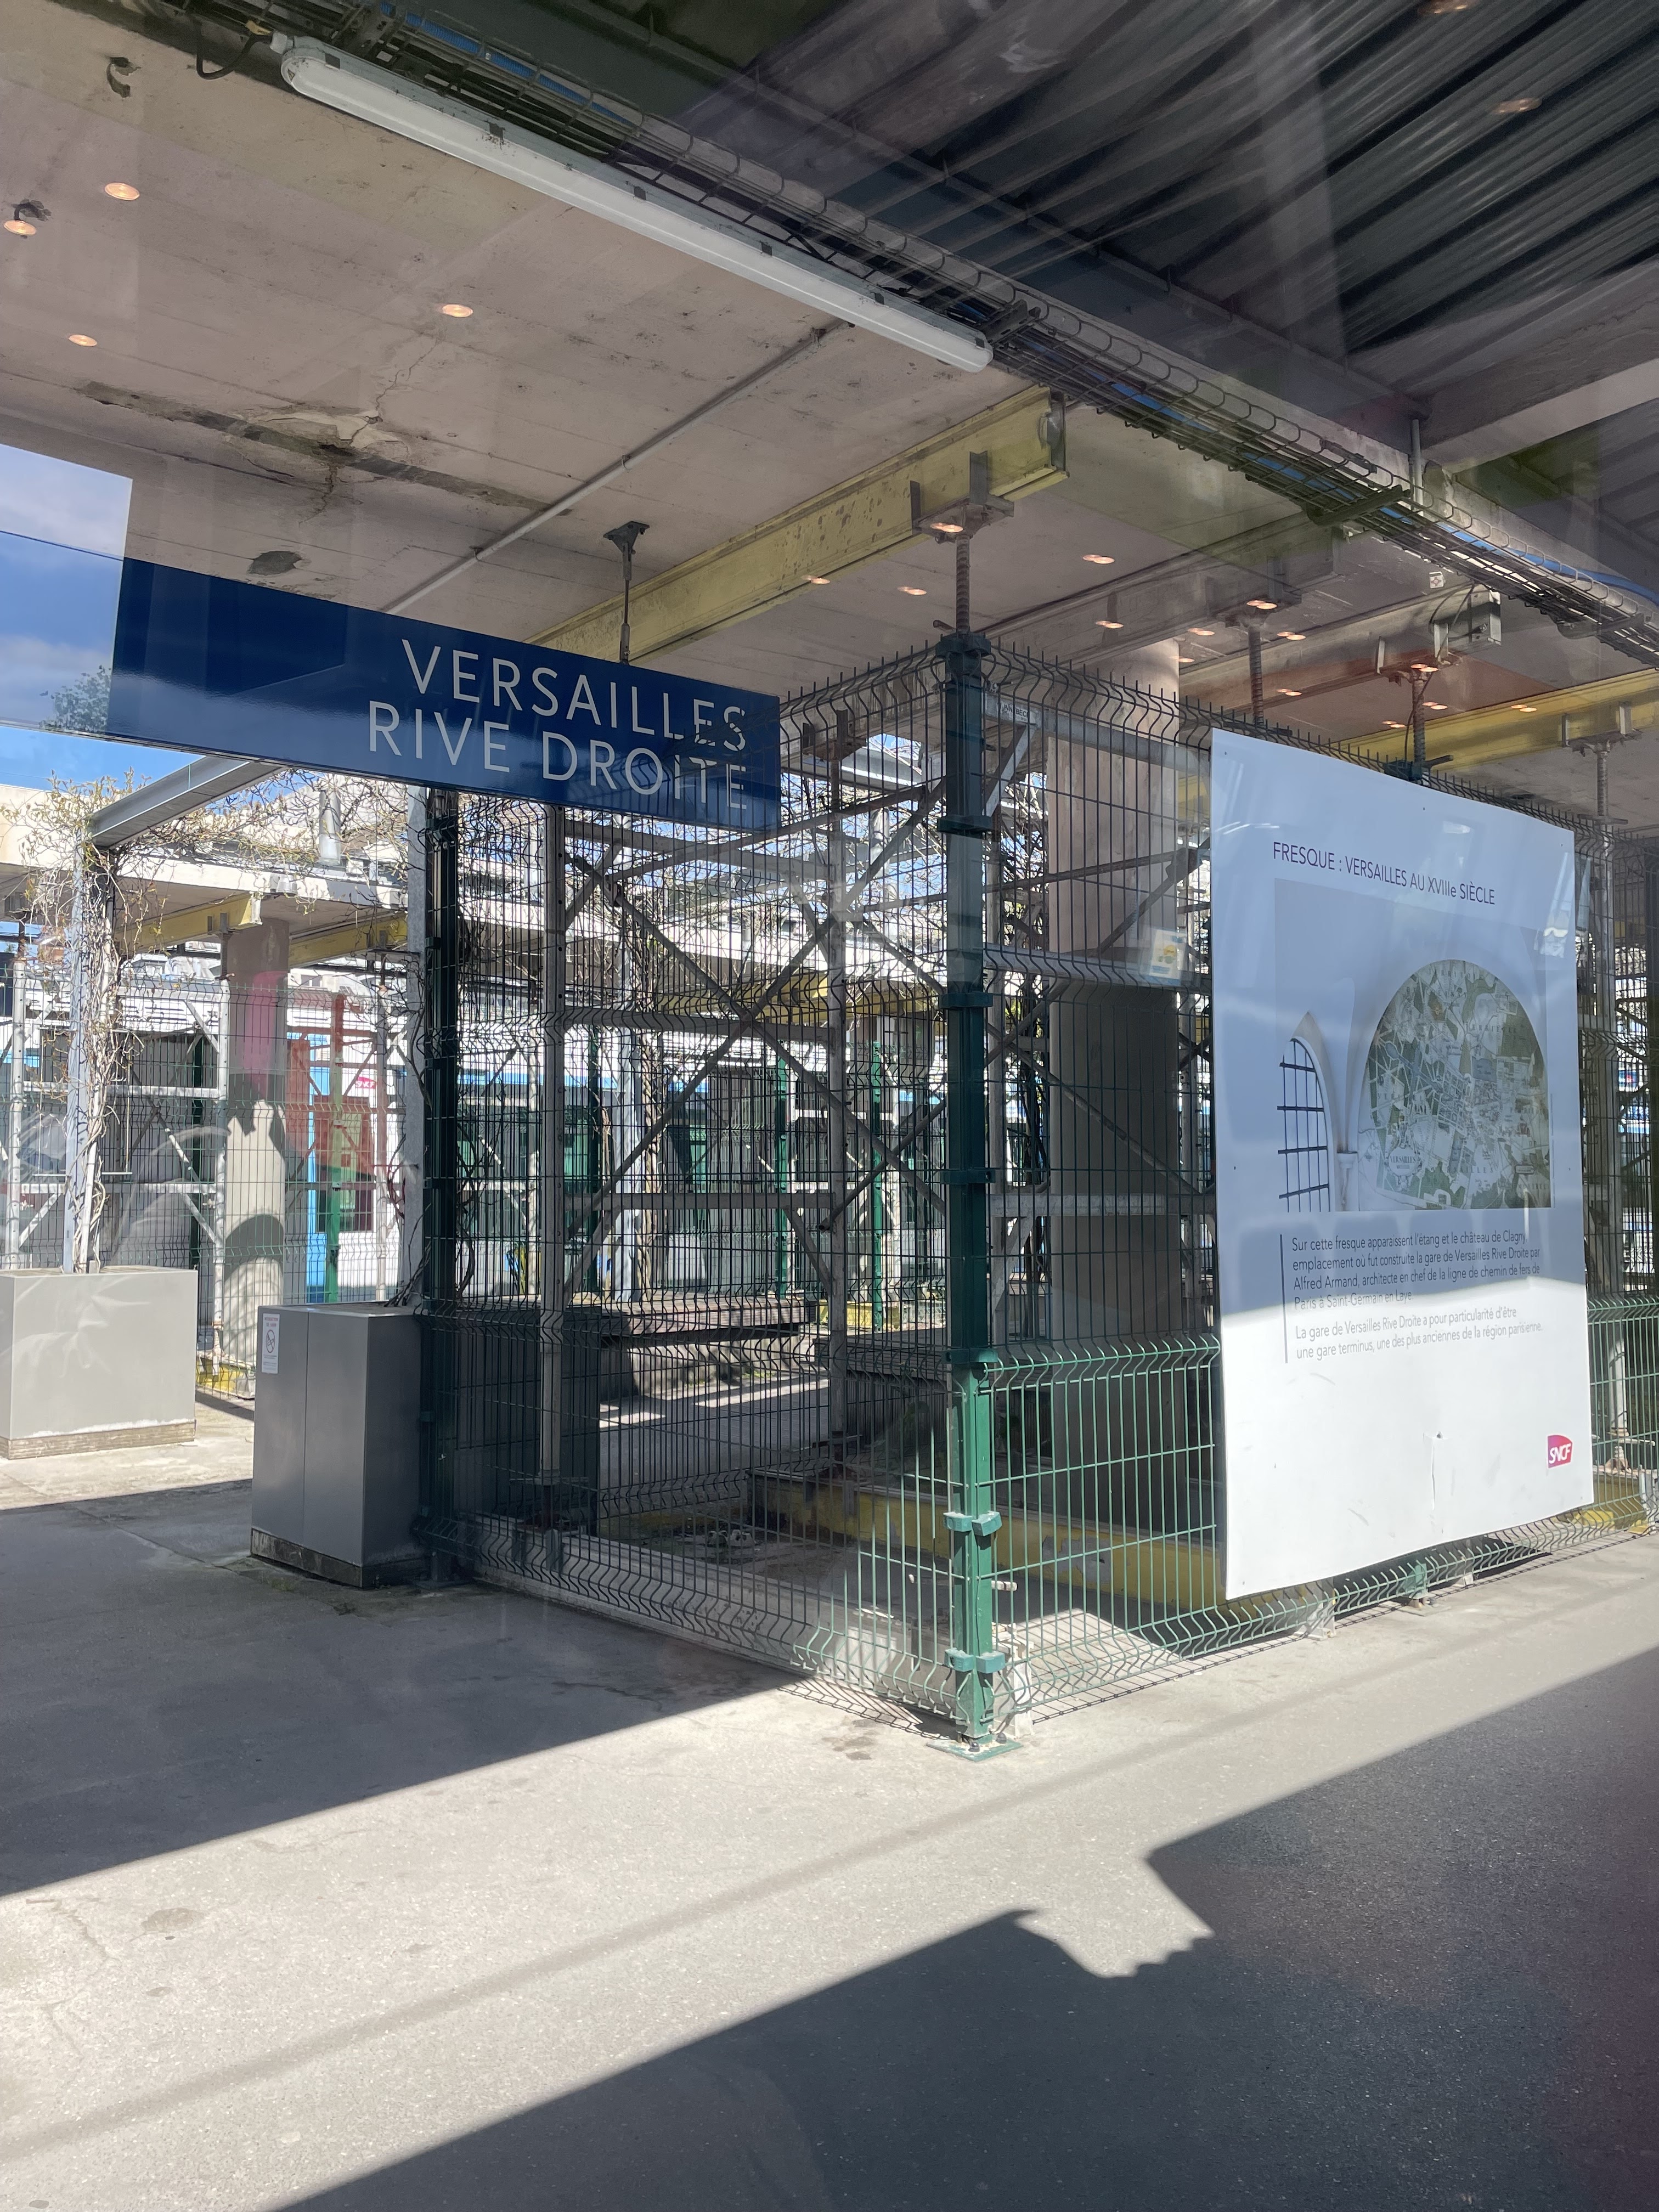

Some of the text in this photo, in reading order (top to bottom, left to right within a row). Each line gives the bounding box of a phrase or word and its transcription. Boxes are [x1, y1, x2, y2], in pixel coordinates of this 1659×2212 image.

[402, 639, 746, 752] VERSAILLES
[369, 700, 747, 810] RIVE DROITE
[1273, 841, 1335, 871] FRESQUE
[1345, 855, 1407, 887] VERSAILLES
[1409, 873, 1425, 891] AU
[1427, 876, 1457, 898] XVIIIe
[1459, 881, 1496, 905] SIÈCLE
[1292, 1228, 1528, 1252] Sur cette fresque apparaissent l'étang et le château de Clagny,
[1293, 1246, 1541, 1274] emplacement où fut construite la gare de Versailles Rive Droite par
[1293, 1262, 1541, 1290] Alfred Armand, architecte en chef de la ligne de chemin de fers de
[1294, 1296, 1316, 1311] Paris
[1319, 1295, 1324, 1308] à
[1326, 1292, 1383, 1308] Saint-Germain
[1385, 1293, 1393, 1302] en
[1296, 1305, 1517, 1342] La gare de Versailles Rive Droite a pour particularité d'être
[1296, 1347, 1314, 1359] une
[1316, 1345, 1336, 1361] gare
[1338, 1338, 1375, 1355] terminus,
[1376, 1339, 1390, 1350] une
[1392, 1334, 1405, 1347] des
[1406, 1331, 1421, 1349] plus
[1423, 1329, 1460, 1344] anciennes
[1462, 1326, 1472, 1340] de
[1474, 1325, 1481, 1339] la
[1482, 1324, 1507, 1340] région
[1549, 1443, 1571, 1464] SNCF
